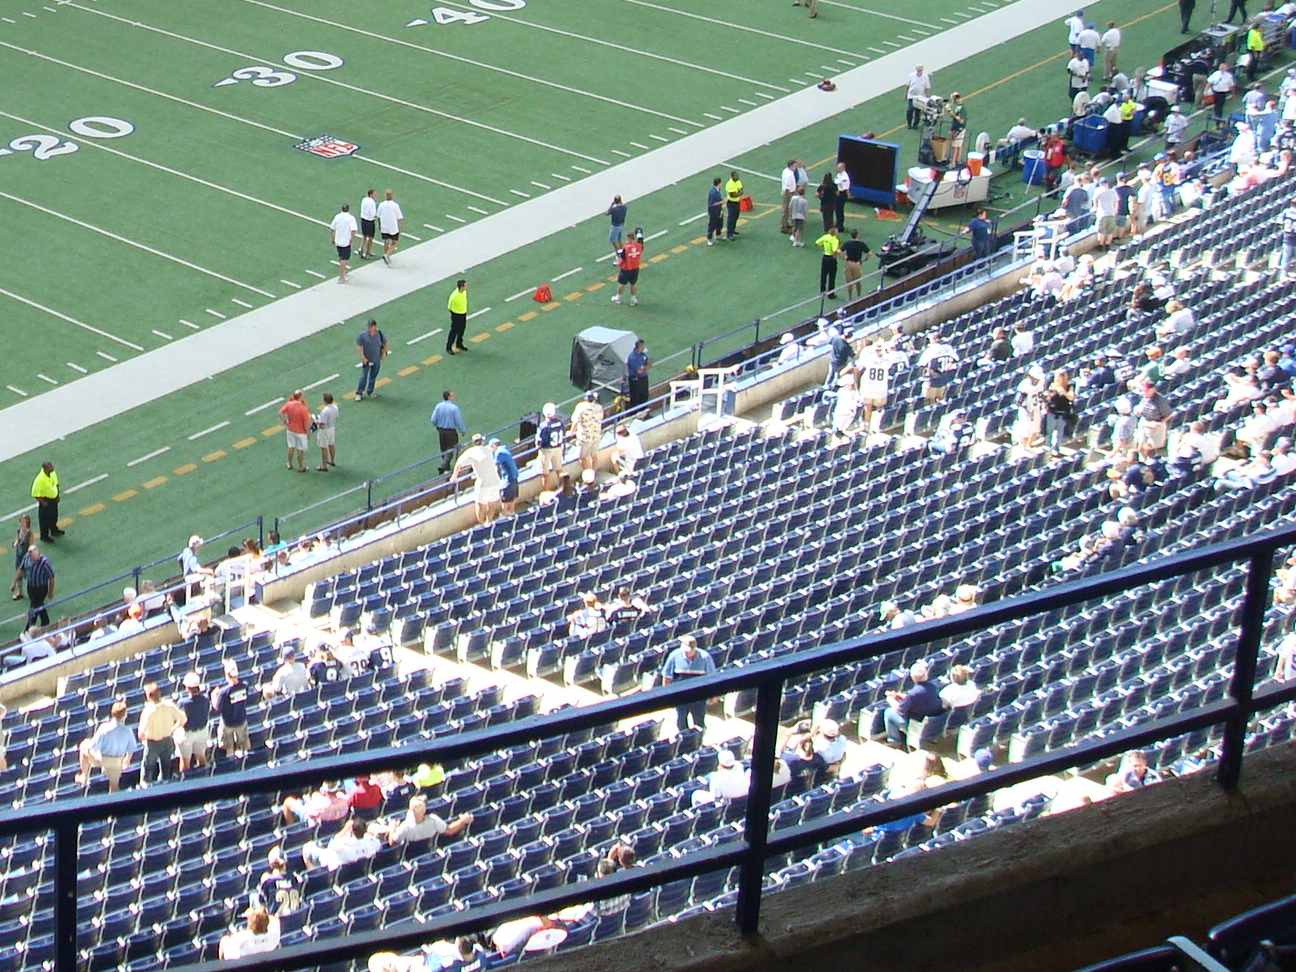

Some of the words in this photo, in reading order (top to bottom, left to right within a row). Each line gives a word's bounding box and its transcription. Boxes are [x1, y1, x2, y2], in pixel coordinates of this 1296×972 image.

[230, 49, 346, 89] 30
[6, 115, 136, 161] 20
[869, 367, 885, 382] 88
